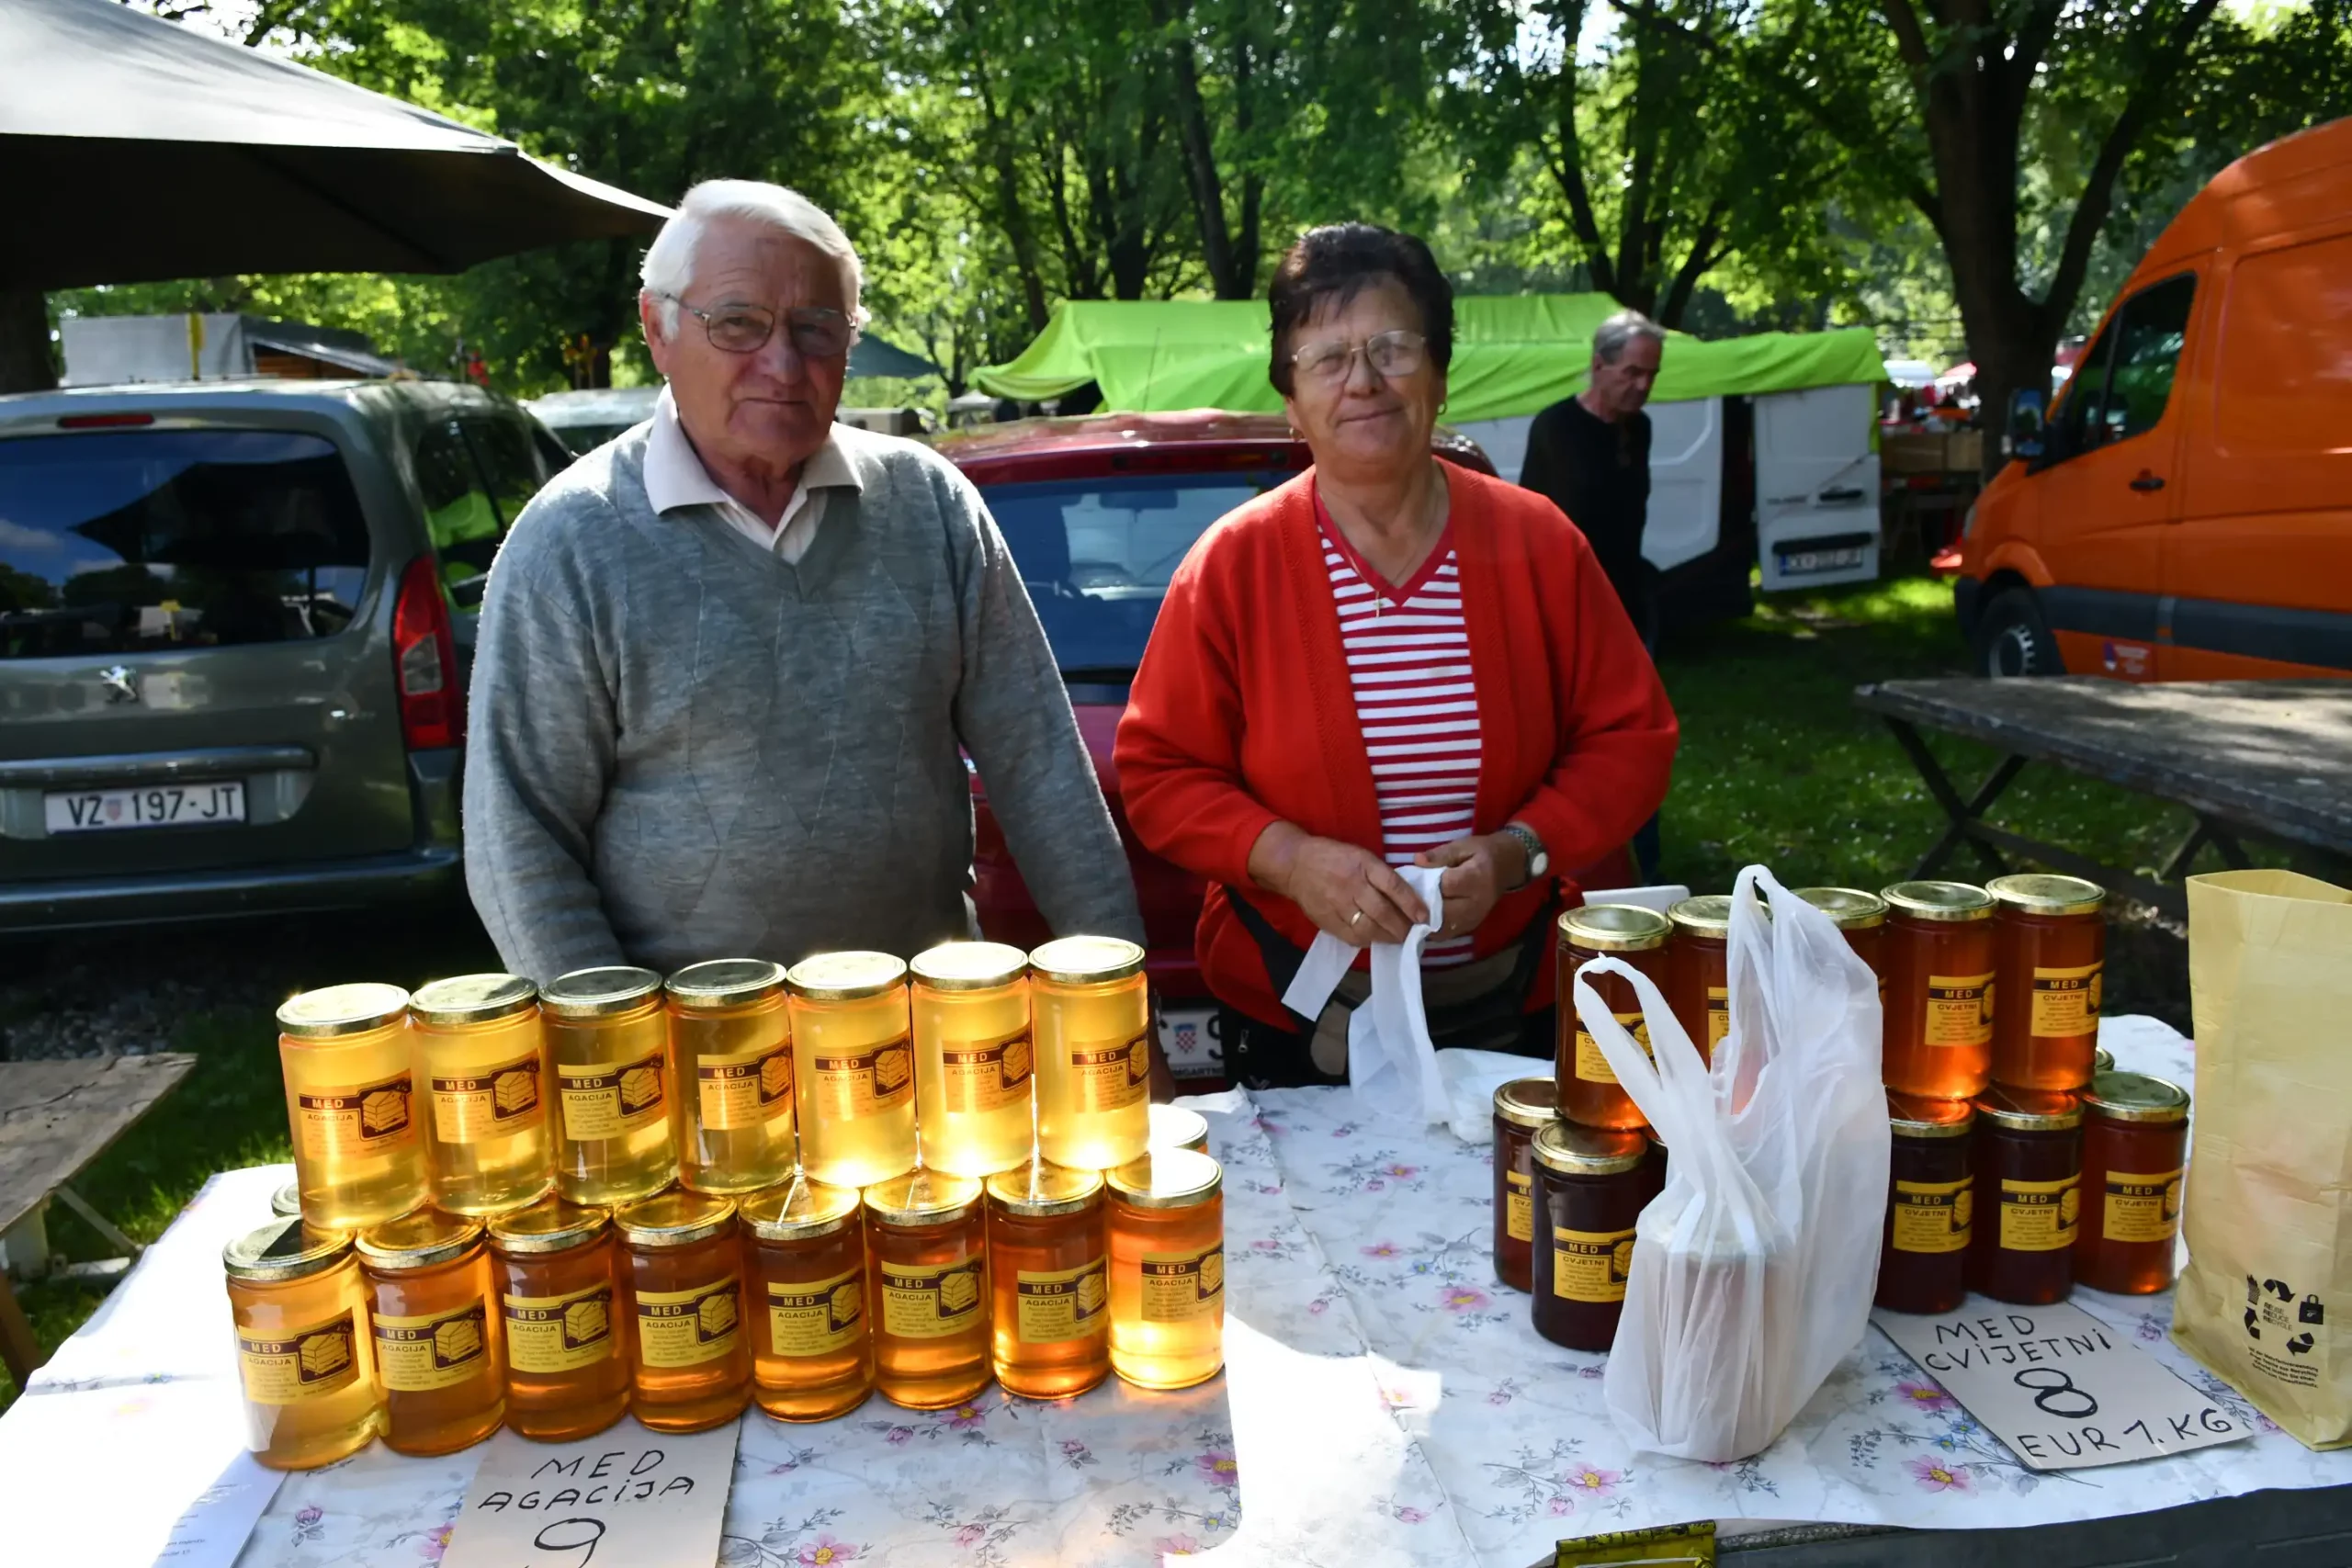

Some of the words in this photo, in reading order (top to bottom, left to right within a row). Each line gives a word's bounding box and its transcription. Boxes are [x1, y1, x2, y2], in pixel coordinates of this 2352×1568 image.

[66, 796, 105, 827] VZ
[2050, 980, 2078, 989] MED
[1945, 989, 1973, 998] MED
[957, 1053, 988, 1063] MED
[1087, 1052, 1116, 1064] MED
[829, 1059, 859, 1070] MED
[714, 1067, 745, 1078] MED
[446, 1080, 477, 1091] MED
[572, 1078, 603, 1089] MED
[311, 1099, 345, 1110] MED
[2122, 1186, 2153, 1195] MED
[1912, 1195, 1940, 1205] MED
[2018, 1194, 2047, 1203] MED
[2115, 1199, 2158, 1207] CVJETNI
[1905, 1209, 1947, 1217] CVJETNI
[1568, 1243, 1599, 1254] MED
[1563, 1256, 1605, 1266] CVJETNI
[1157, 1265, 1186, 1274] MED
[894, 1278, 923, 1289] MED
[1149, 1278, 1193, 1286] AGACIJA
[1033, 1284, 1062, 1294] MED
[784, 1296, 815, 1306] MED
[888, 1292, 933, 1301] AGACIJA
[1025, 1298, 1070, 1306] AGACIJA
[517, 1310, 548, 1320] MED
[651, 1305, 682, 1316] MED
[777, 1310, 823, 1319] AGACIJA
[646, 1319, 691, 1328] AGACIJA
[2263, 1315, 2293, 1331] RECYCLE
[514, 1324, 557, 1333] AGACIJA
[1935, 1315, 2035, 1344] MED
[386, 1329, 416, 1340] MED
[251, 1342, 281, 1353] MED
[382, 1345, 426, 1353] AGACIJA
[2013, 1368, 2098, 1418] 8
[2017, 1427, 2120, 1459] EUR
[531, 1450, 664, 1479] MED
[534, 1517, 606, 1568] 9
